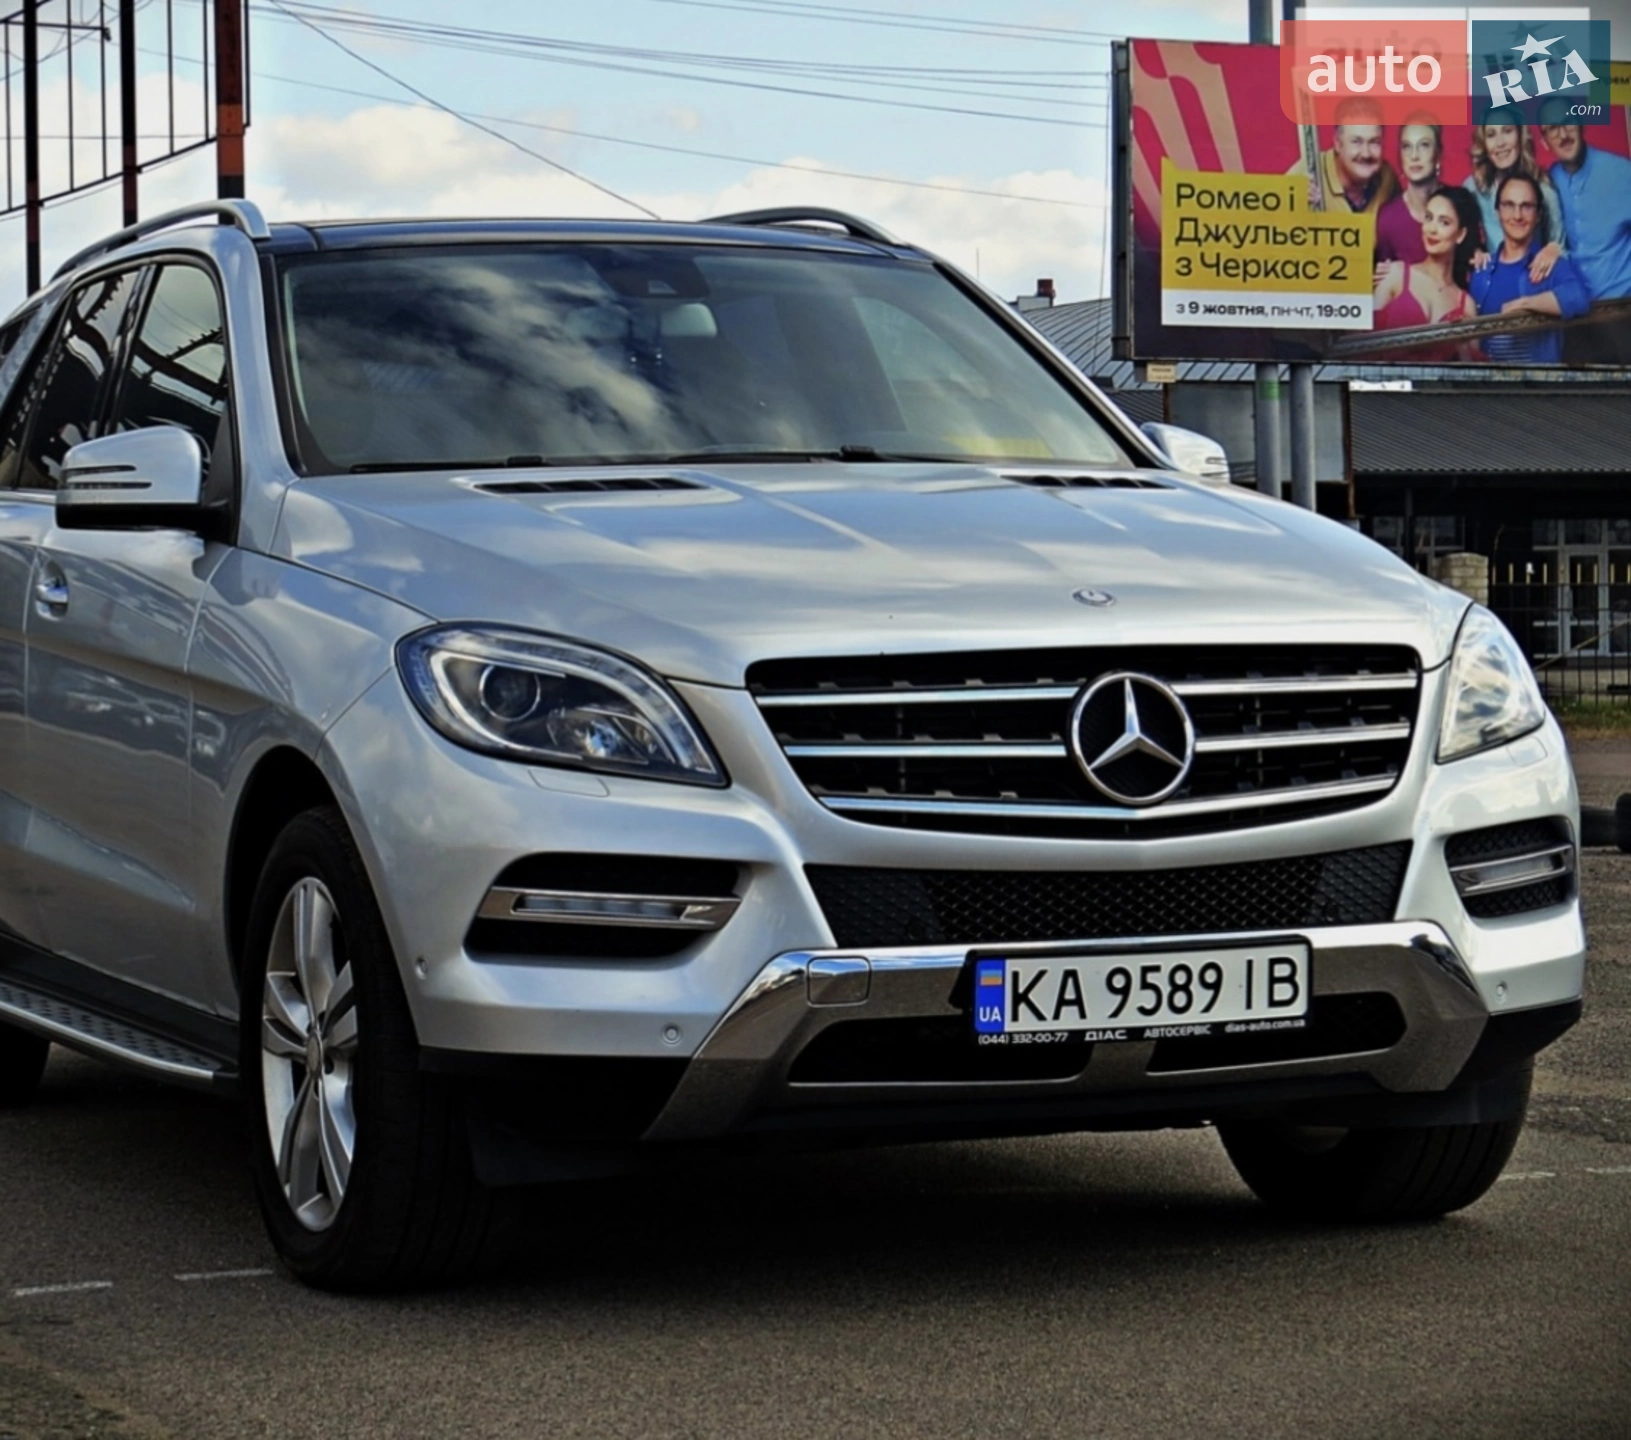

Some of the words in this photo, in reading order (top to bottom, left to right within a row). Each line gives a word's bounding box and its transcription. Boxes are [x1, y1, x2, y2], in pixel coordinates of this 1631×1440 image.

[1175, 183, 1281, 211] Ромео
[1288, 187, 1295, 211] і
[1174, 217, 1360, 249] Джульєтта
[1175, 256, 1192, 277] з
[1200, 252, 1320, 283] Черкас
[1328, 255, 1348, 280] 2
[1176, 303, 1185, 314] з
[1188, 301, 1199, 315] 9
[1202, 303, 1268, 317] жовтня,
[1316, 304, 1361, 318] 19:00
[1010, 968, 1087, 1022] KA
[1105, 961, 1223, 1019] 9589
[1245, 957, 1300, 1010] IB
[979, 1006, 1002, 1022] UA
[978, 1033, 1009, 1045] (044)
[1011, 1031, 1069, 1044] 332-00-77
[1224, 1018, 1306, 1034] dias-auto.com.ua
